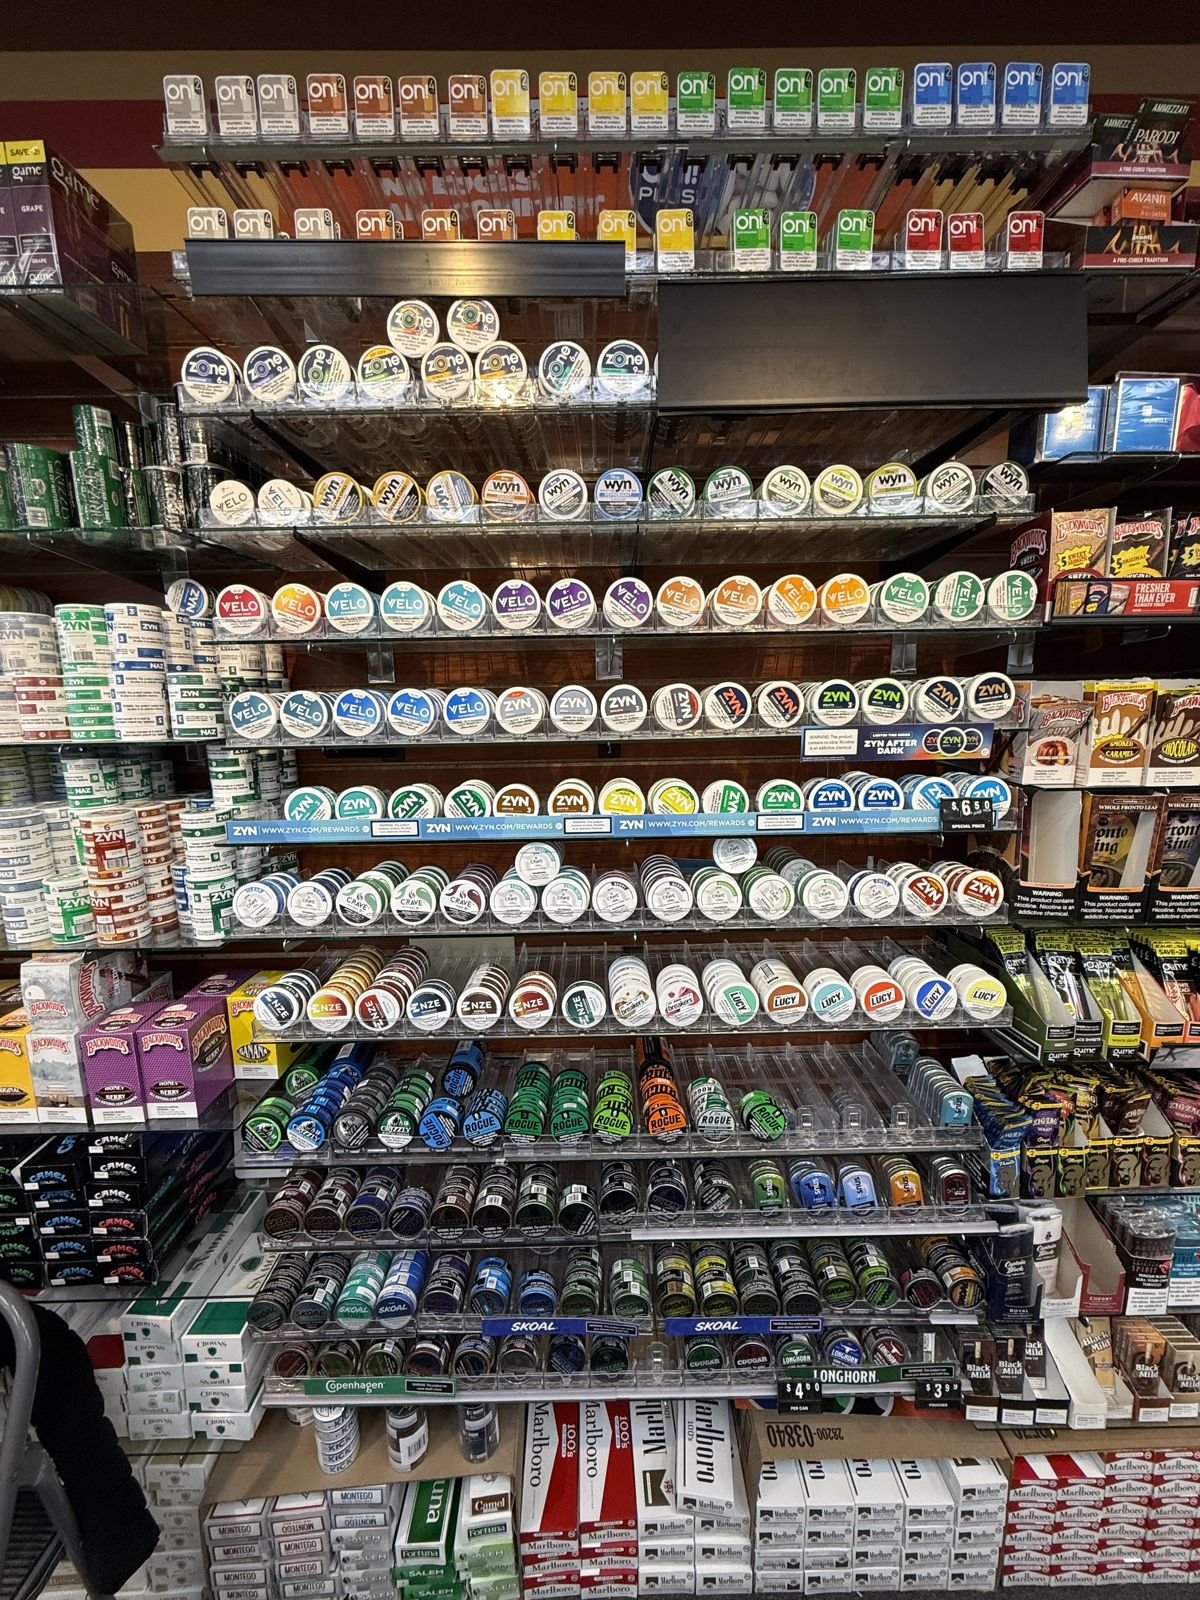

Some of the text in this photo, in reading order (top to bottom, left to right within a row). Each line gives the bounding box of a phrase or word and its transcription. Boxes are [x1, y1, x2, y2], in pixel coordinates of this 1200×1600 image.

[777, 77, 805, 93] on!
[917, 71, 944, 87] on!
[1055, 71, 1082, 87] on!
[166, 83, 195, 101] on!
[309, 82, 337, 98] on!
[400, 84, 429, 100] on!
[680, 79, 707, 95] on!
[1134, 129, 1180, 144] PARODI
[12, 165, 41, 182] game
[21, 205, 43, 213] GRAPE
[190, 215, 218, 232] on!
[840, 217, 866, 232] on!
[950, 219, 977, 234] on!
[878, 473, 907, 487] wyn
[999, 466, 1023, 490] wyn
[493, 480, 520, 493] wyn
[547, 477, 570, 497] wyn
[604, 479, 631, 492] wyn
[320, 479, 340, 508] wyn
[1057, 520, 1105, 541] BACKWOODS
[1113, 520, 1163, 543] BACKWOODS
[890, 585, 924, 602] VELO
[1136, 583, 1170, 592] FRESHER
[448, 591, 481, 613] VELO
[498, 595, 535, 608] VELO
[666, 588, 700, 607] VELO
[722, 588, 756, 605] VELO
[1135, 593, 1175, 603] THAN EVER
[221, 601, 258, 612] VELO
[330, 598, 367, 610] VELO
[64, 621, 90, 631] ZYN
[873, 689, 901, 702] ZYN
[979, 684, 1005, 696] ZYN
[560, 697, 588, 709] ZYN
[609, 696, 637, 709] ZYN
[824, 692, 851, 702] ZYN
[1102, 693, 1147, 712] BACKWOODS
[340, 702, 375, 717] VELO
[396, 701, 430, 717] VELO
[504, 698, 531, 711] ZYN
[234, 703, 268, 721] VELO
[864, 739, 917, 748] ZYN AFTER
[1161, 741, 1198, 755] CHOCOLATE
[877, 747, 904, 755] DARK
[1105, 749, 1135, 757] CARAMEL
[502, 796, 529, 807] ZYN
[557, 795, 584, 805] ZYN
[768, 792, 794, 802] ZYN
[819, 791, 845, 801] ZYN
[868, 790, 894, 801] ZYN
[343, 798, 371, 809] ZYN
[427, 823, 451, 833] ZYN
[455, 822, 553, 832] WWW.ZYN.COM/REWARDS
[620, 820, 643, 830] ZYN
[648, 819, 745, 829] WWW.ZYN.COM/REWARDS
[812, 816, 836, 826] ZYN
[841, 816, 937, 825] WWW.ZYN.COM/REWARDS
[94, 832, 124, 842] ZYN
[233, 827, 257, 836] ZYN
[262, 826, 360, 834] WWW.ZYN.COM/REWARDS
[916, 878, 942, 902] ZYN
[972, 880, 998, 897] ZYN
[1097, 901, 1115, 909] product
[775, 996, 797, 1007] LUCY
[821, 994, 842, 1009] LUCY
[871, 992, 893, 1007] LUCY
[973, 990, 996, 1001] LUCY
[31, 1001, 68, 1016] BACKWOODS
[621, 999, 645, 1014] breakers
[668, 996, 693, 1012] breakers
[86, 1037, 129, 1055] BACKWOODS
[142, 1034, 183, 1051] BACKWOODS
[237, 1044, 271, 1059] BANANA
[508, 1119, 539, 1130] ROGUE
[553, 1117, 583, 1131] ROGUE
[597, 1115, 628, 1130] ROGUE
[702, 1115, 731, 1124] ROGUE
[380, 1125, 411, 1134] GRIZZLY
[99, 1161, 137, 1174] CAMEL
[29, 1170, 67, 1183] CAMEL
[45, 1216, 82, 1228] CAMEL
[98, 1217, 135, 1230] CAMEL
[378, 1305, 408, 1314] SKOAL
[511, 1321, 556, 1331] SKOAL
[695, 1321, 739, 1332] SKOAL
[1083, 1333, 1109, 1347] Black
[689, 1359, 721, 1367] COUGAR
[737, 1356, 768, 1366] COUGAR
[782, 1355, 811, 1364] LONGHORN
[967, 1364, 990, 1372] Black
[970, 1371, 990, 1379] Mild
[326, 1379, 384, 1393] Copenhagen
[620, 1416, 628, 1449] 100's
[530, 1402, 549, 1487] Marlboro
[566, 1424, 576, 1457] 100's
[329, 1448, 351, 1462] KICK
[1109, 1462, 1148, 1472] Marlboro
[341, 1492, 373, 1501] MONTEGO
[1013, 1490, 1052, 1498] Marlboro
[475, 1498, 505, 1511] Camel
[219, 1526, 252, 1534] MONTEGO
[589, 1531, 630, 1541] Marlboro
[401, 1550, 439, 1558] Fortuna
[409, 1569, 444, 1577] SALEM
